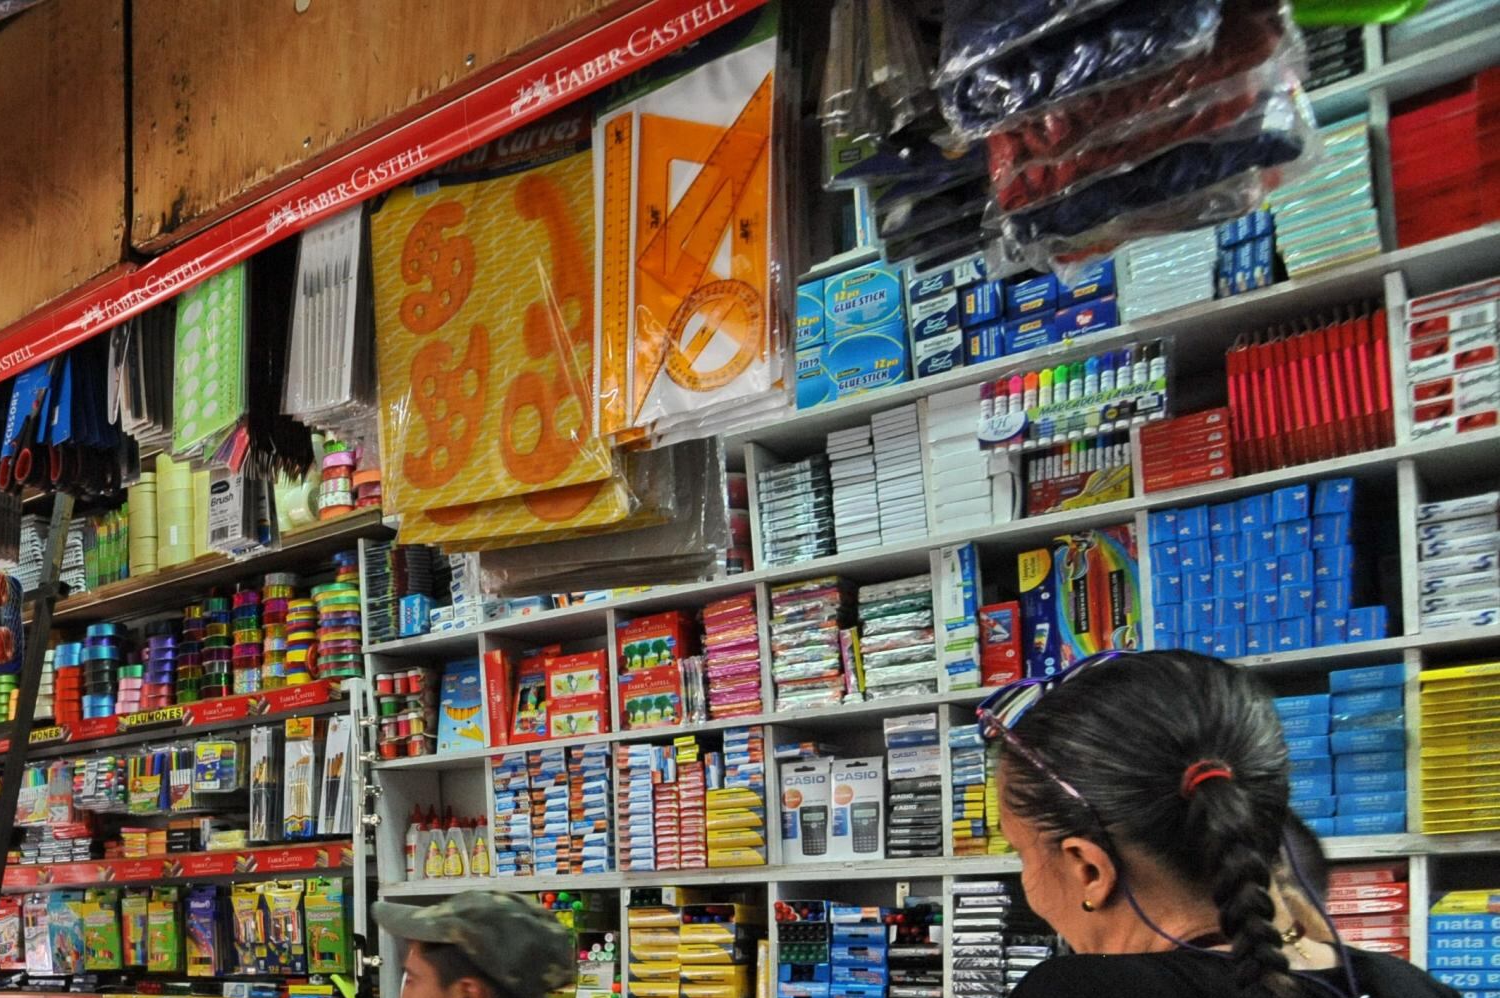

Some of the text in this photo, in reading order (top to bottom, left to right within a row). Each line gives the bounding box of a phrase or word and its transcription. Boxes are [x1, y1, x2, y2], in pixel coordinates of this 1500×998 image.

[554, 0, 736, 97] FABER-CASTELL
[296, 144, 428, 219] FABER-CASTELL
[102, 256, 207, 319] FABER-CASTELL
[834, 288, 887, 314] GLUE STICK
[838, 369, 889, 390] GLUE STICK
[4, 391, 20, 446] SCISSORS
[210, 492, 234, 508] Brush
[129, 707, 183, 726] PLUMONES
[784, 774, 825, 786] CASIO
[835, 770, 878, 782] CASIO
[1436, 917, 1484, 930] nata
[1437, 936, 1484, 949] nata
[1436, 953, 1484, 966] nata
[1440, 973, 1479, 986] 624
